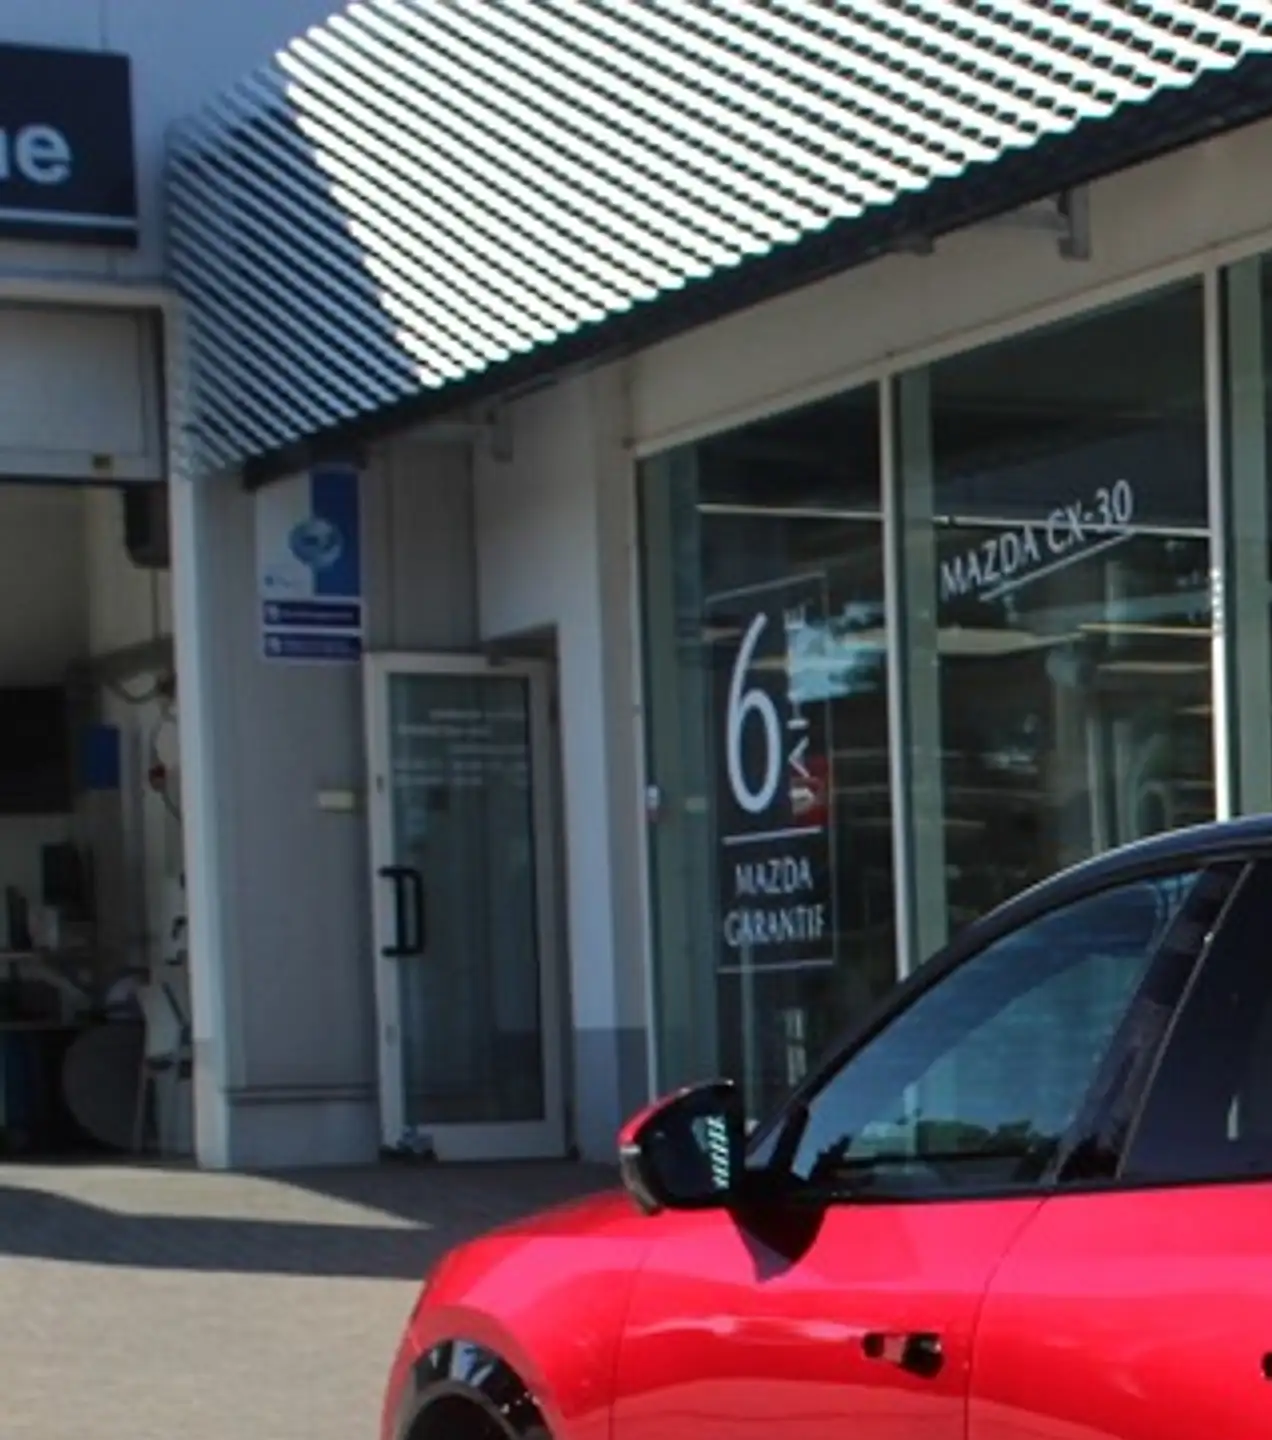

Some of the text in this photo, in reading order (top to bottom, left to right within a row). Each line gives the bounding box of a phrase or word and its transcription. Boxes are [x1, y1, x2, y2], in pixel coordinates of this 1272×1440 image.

[0, 124, 71, 183] e
[939, 478, 1134, 600] MAZDA CX-30
[726, 612, 782, 813] 6
[734, 856, 814, 895] MAZDA
